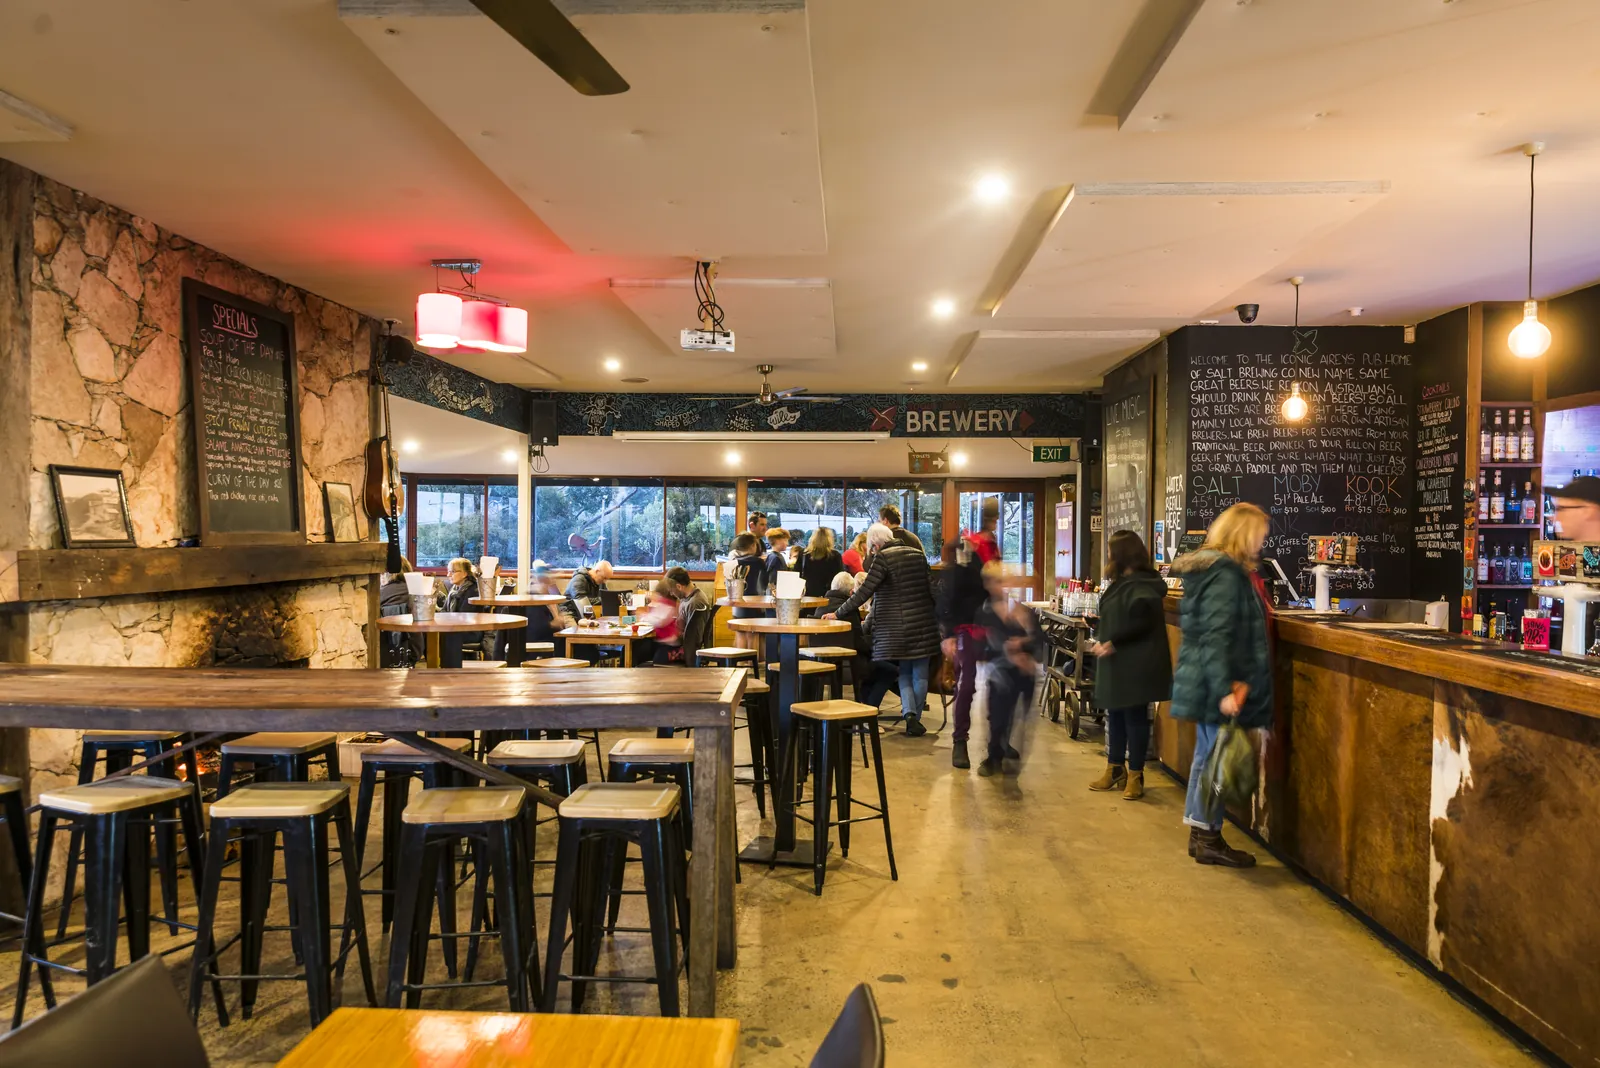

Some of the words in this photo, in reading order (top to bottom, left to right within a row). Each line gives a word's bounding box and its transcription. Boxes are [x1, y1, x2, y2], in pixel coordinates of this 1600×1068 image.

[213, 304, 258, 336] SPECIALS
[200, 329, 225, 345] SOUP
[228, 338, 239, 351] OF
[241, 340, 256, 356] THE
[260, 344, 273, 360] DAY
[1190, 355, 1229, 366] WELCOME
[1237, 354, 1250, 365] TO
[1255, 354, 1274, 365] THE
[1280, 354, 1313, 365] ICONIC
[1320, 354, 1356, 366] AIREYS
[1362, 353, 1382, 366] PUB
[1384, 354, 1412, 366] HOME
[1190, 370, 1202, 380] OF
[1206, 368, 1233, 379] SALT
[1239, 366, 1278, 379] BREWING
[1281, 368, 1296, 378] CO
[1299, 367, 1320, 379] NEW
[1360, 368, 1391, 380] SAME
[1190, 380, 1225, 392] GREAT
[1324, 382, 1395, 395] AUSTRALIANS
[1422, 382, 1451, 398] COCKTAILS
[1190, 392, 1227, 405] SHOULD
[1232, 392, 1262, 405] DRINK
[1331, 394, 1366, 405] BEERS!
[1386, 395, 1407, 406] ALL
[664, 410, 694, 423] CUSTOM
[1191, 406, 1210, 418] OUR
[1214, 404, 1240, 416] BEERS
[1244, 404, 1261, 415] ARE
[1335, 405, 1359, 416] HERE
[1364, 406, 1396, 416] USING
[204, 414, 225, 427] SPICY
[253, 424, 277, 437] CUTLETS
[654, 419, 681, 429] SHAPED
[683, 415, 701, 427] BEER
[730, 420, 750, 431] MUSIC
[735, 415, 749, 426] LIVE
[906, 410, 1018, 433] BREWERY
[1191, 418, 1226, 430] MAINLY
[1230, 417, 1255, 428] LOCAL
[1316, 415, 1327, 424] BY
[1331, 415, 1350, 425] OUR
[1351, 416, 1371, 425] OWN
[1374, 416, 1410, 429] ARTISAN
[1247, 429, 1269, 440] BREW
[1273, 428, 1299, 438] BEERS
[1302, 428, 1317, 437] FOR
[1321, 427, 1364, 437] EVERYONE
[1366, 428, 1387, 440] FROM
[1388, 430, 1410, 441] YOUR
[1192, 442, 1240, 453] TRADITIONAL
[1244, 442, 1267, 452] BEER
[1270, 440, 1305, 451] DRINKER
[1308, 439, 1318, 449] TO
[1320, 439, 1343, 450] YOUR
[1346, 440, 1361, 450] FULL
[1362, 441, 1376, 451] ON
[1380, 441, 1402, 452] BEER
[1040, 447, 1063, 460] EXIT
[1255, 453, 1273, 462] NOT
[1277, 452, 1300, 461] SURE
[1304, 452, 1336, 462] WHATS
[1340, 453, 1365, 463] WHAT
[1365, 453, 1388, 464] JUST
[1388, 456, 1407, 467] ASK
[1192, 464, 1204, 473] OR
[1208, 464, 1232, 474] GRAB
[1235, 464, 1244, 474] A
[1246, 463, 1277, 475] PADDLE
[1280, 464, 1298, 476] AND
[1301, 463, 1318, 474] TRY
[1321, 463, 1344, 474] THEM
[1348, 464, 1365, 476] ALL
[234, 475, 243, 487] OF
[245, 475, 257, 489] THE
[1166, 474, 1184, 494] WATER
[1192, 476, 1243, 496] SALT
[1274, 474, 1321, 494] MOBY
[1346, 475, 1402, 499] KOOK
[1166, 495, 1183, 511] REFILL
[1293, 494, 1310, 504] PALE
[1311, 492, 1325, 504] ALE
[1371, 495, 1389, 508] IPA
[1166, 511, 1182, 532] HERE
[1279, 535, 1300, 547] COFFEE
[1382, 533, 1397, 546] IPA
